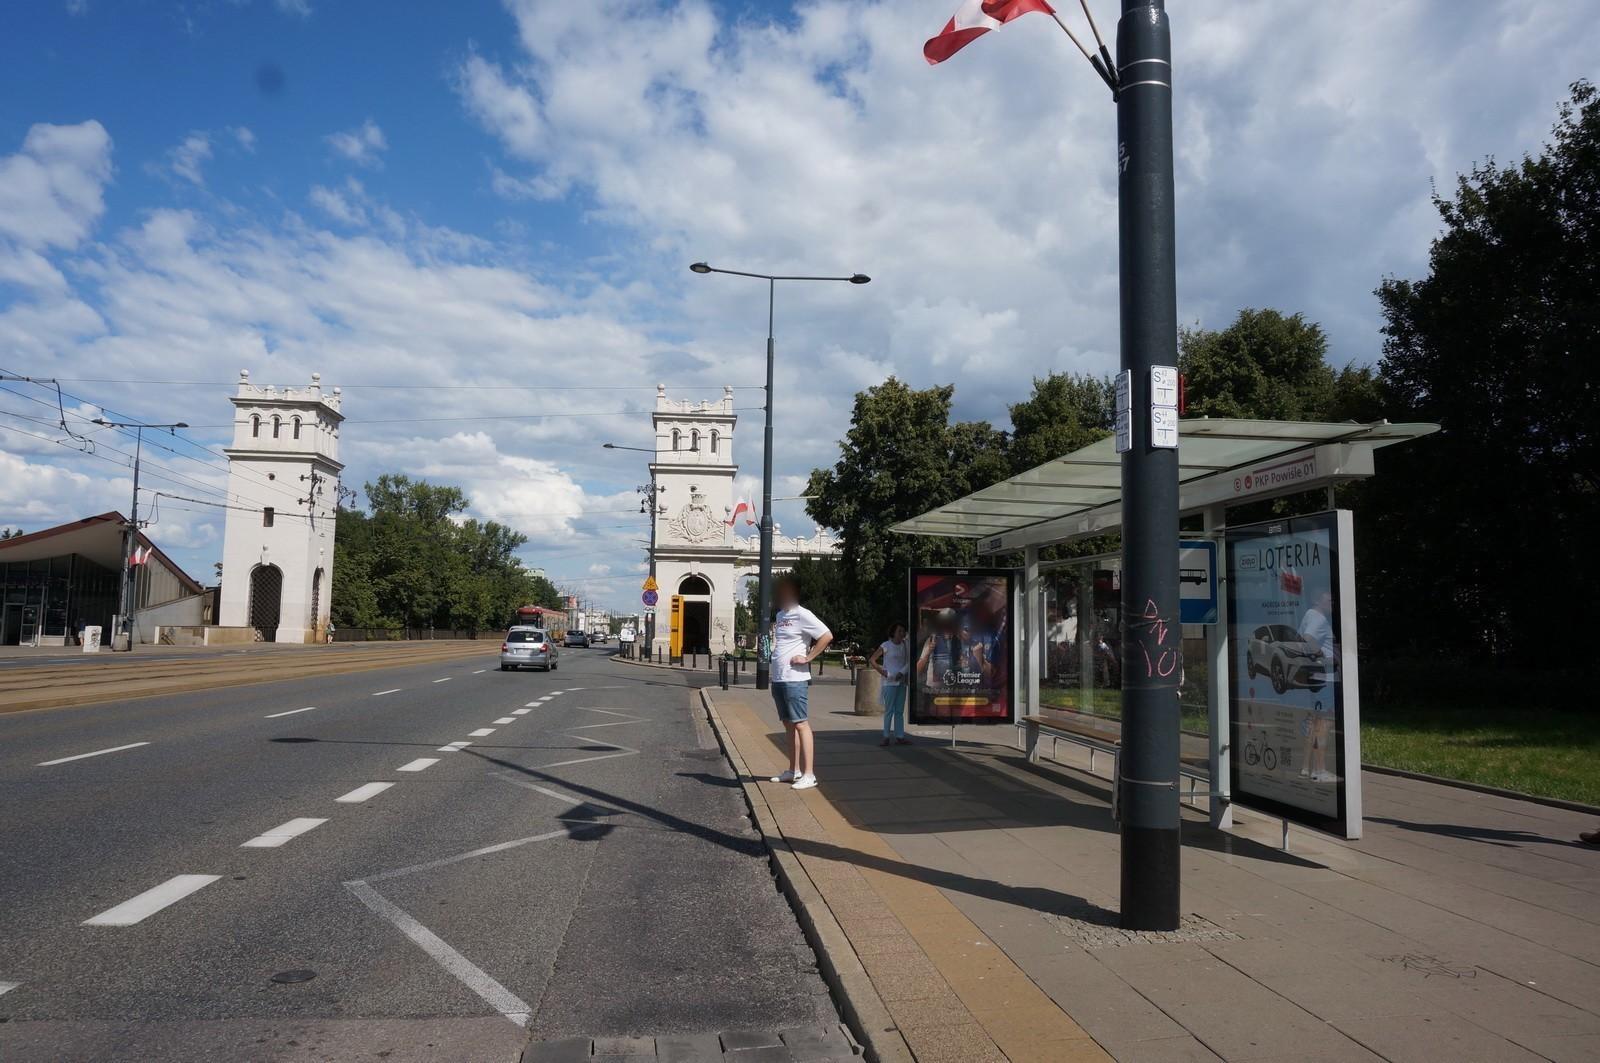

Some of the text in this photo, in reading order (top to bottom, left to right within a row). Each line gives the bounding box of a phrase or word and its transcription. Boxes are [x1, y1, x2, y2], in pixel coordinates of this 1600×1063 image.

[1255, 474, 1269, 487] PKP
[1271, 466, 1303, 484] Powiśle
[1304, 462, 1314, 475] 01
[1259, 542, 1321, 571] LOTERIA
